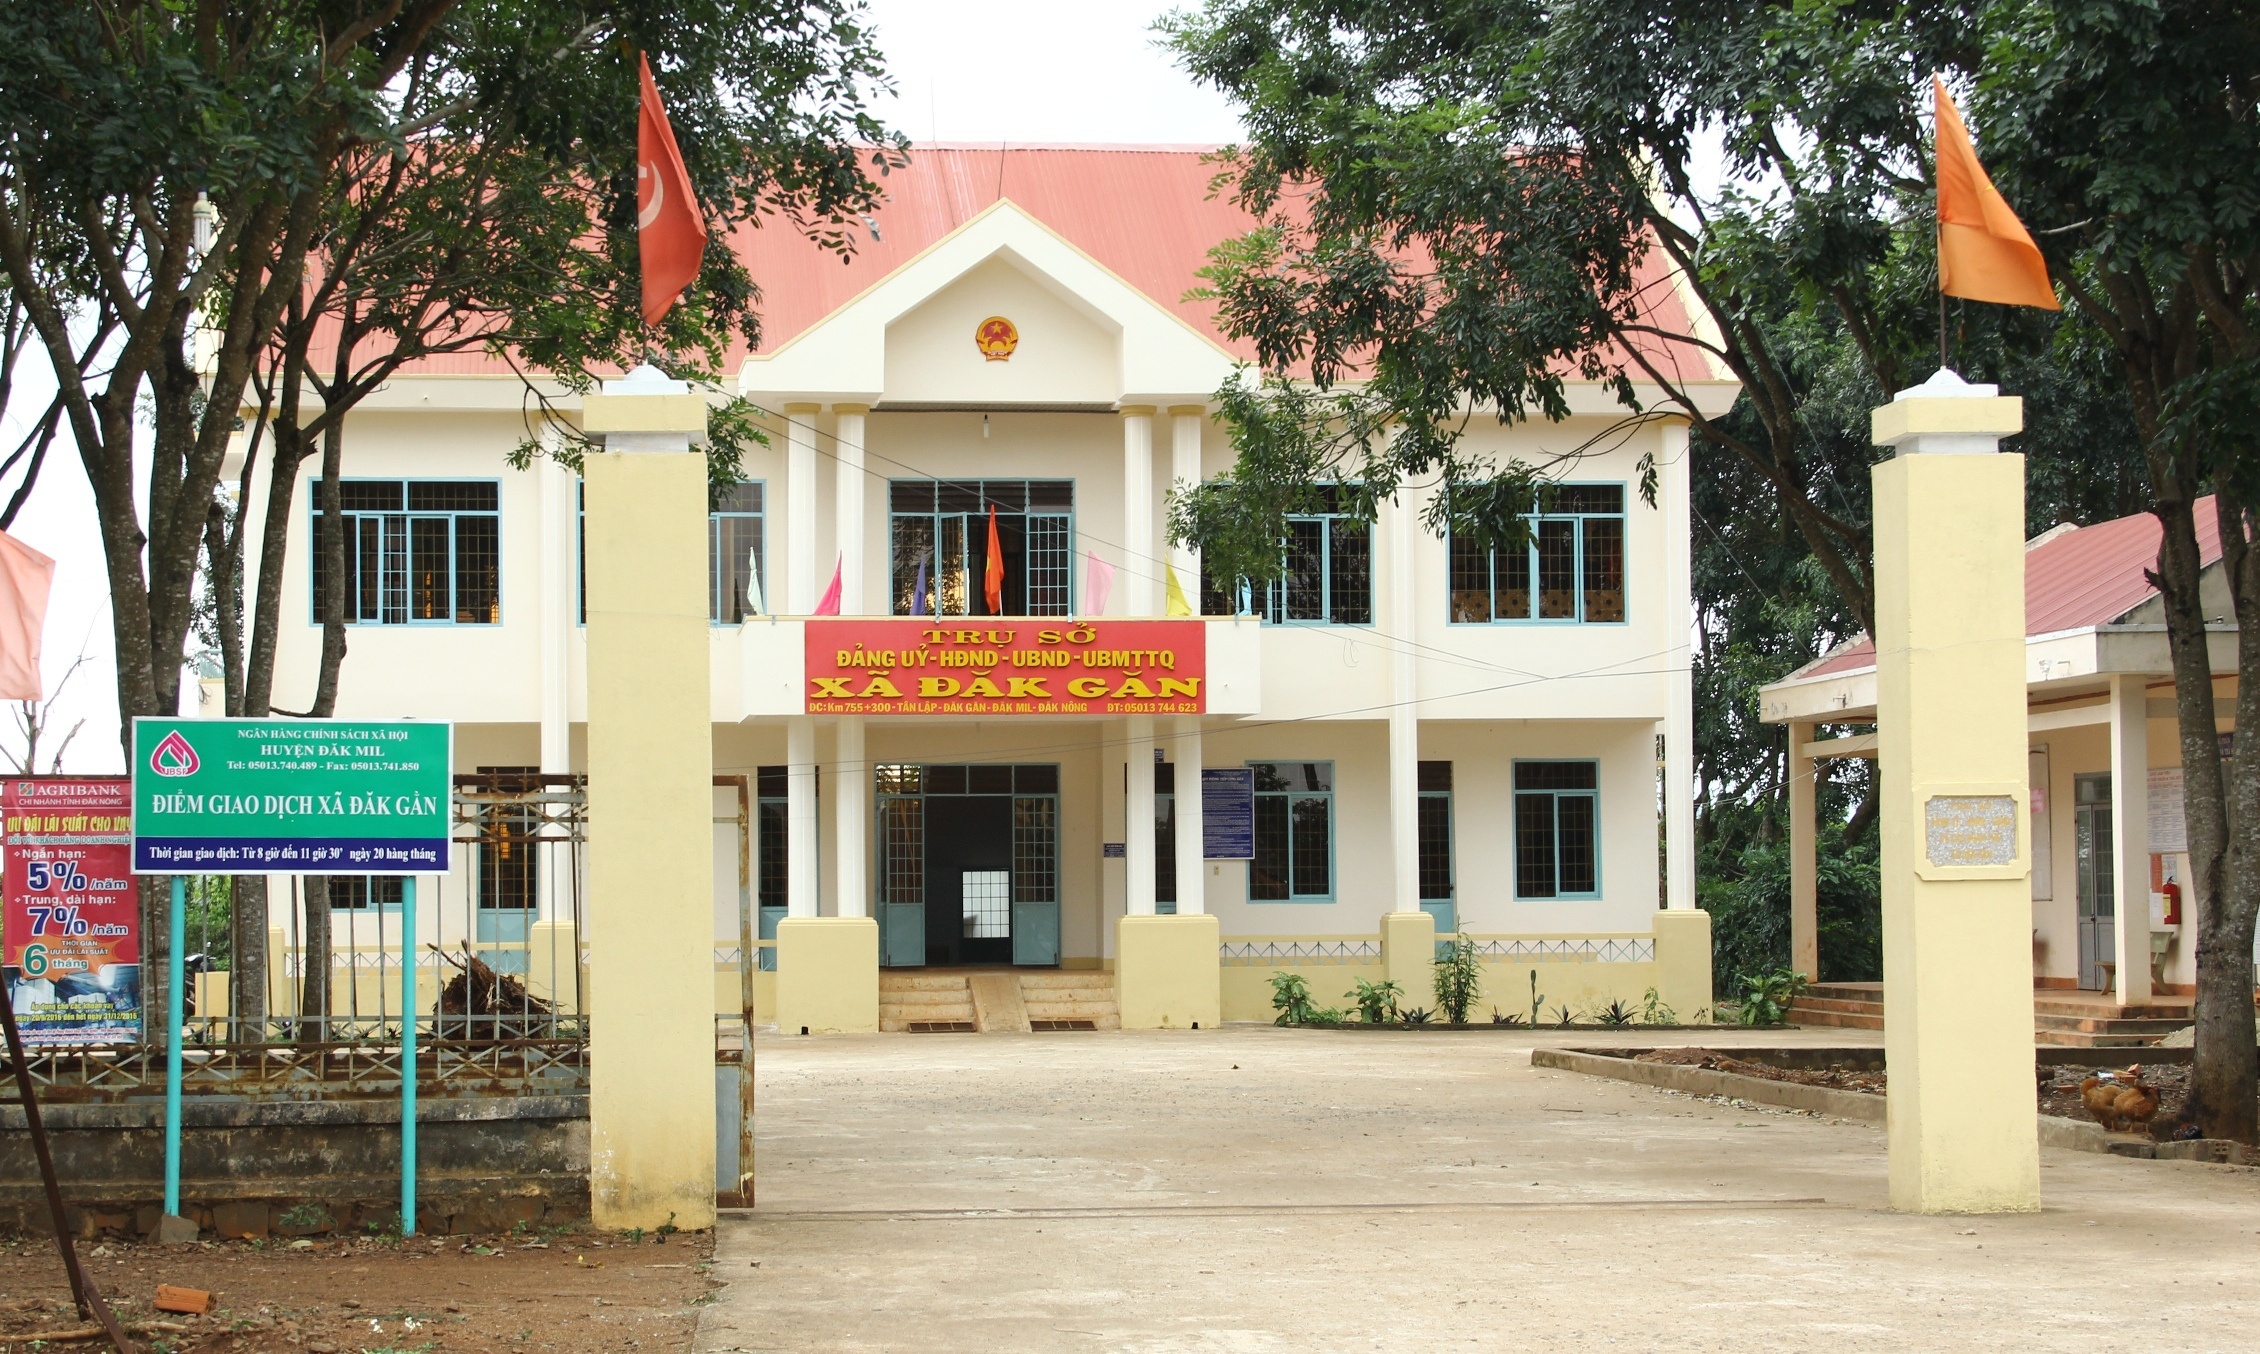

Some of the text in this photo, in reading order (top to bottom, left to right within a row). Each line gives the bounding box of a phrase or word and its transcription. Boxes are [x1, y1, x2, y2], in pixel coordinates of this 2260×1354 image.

[922, 621, 1098, 649] TRỤ SỞ
[836, 642, 896, 668] ĐẢNG
[809, 669, 904, 699] XÃ
[897, 700, 916, 712] TÂN
[1061, 700, 1088, 712] NÔNG
[1124, 702, 1155, 712] 05013
[1158, 702, 1175, 712] 744
[1178, 702, 1198, 712] 623
[238, 727, 408, 742] NGÂN HÀNG CHÍNH SÁCH XÃ HỘI
[260, 742, 385, 759] HUYỆN ĐĂK MIL
[227, 760, 246, 770] Tel:
[326, 761, 349, 771] Fax:
[36, 785, 121, 796] AGRIBANK
[152, 788, 205, 814] ĐIỂM
[208, 794, 260, 815] GIAO
[263, 795, 314, 820] DỊCH
[317, 790, 345, 815] XÃ
[349, 790, 391, 815] ĐĂK
[43, 813, 60, 832] LÃI
[90, 816, 112, 832] CHO
[22, 846, 86, 861] Ngắn hạn:
[149, 846, 172, 859] Thời
[173, 847, 193, 862] gian
[195, 847, 215, 862] giao
[216, 846, 240, 862] dịch:
[242, 846, 256, 859] Từ
[257, 847, 263, 859] 8
[265, 847, 280, 862] giờ
[281, 844, 298, 859] đến
[301, 847, 310, 859] 11
[312, 847, 328, 862] giờ
[349, 847, 371, 863] ngày
[373, 847, 385, 859] 20
[386, 847, 409, 862] hàng
[410, 847, 437, 862] tháng
[22, 894, 116, 906] Trung, dài hạn:
[24, 942, 88, 977] 6 tháng
